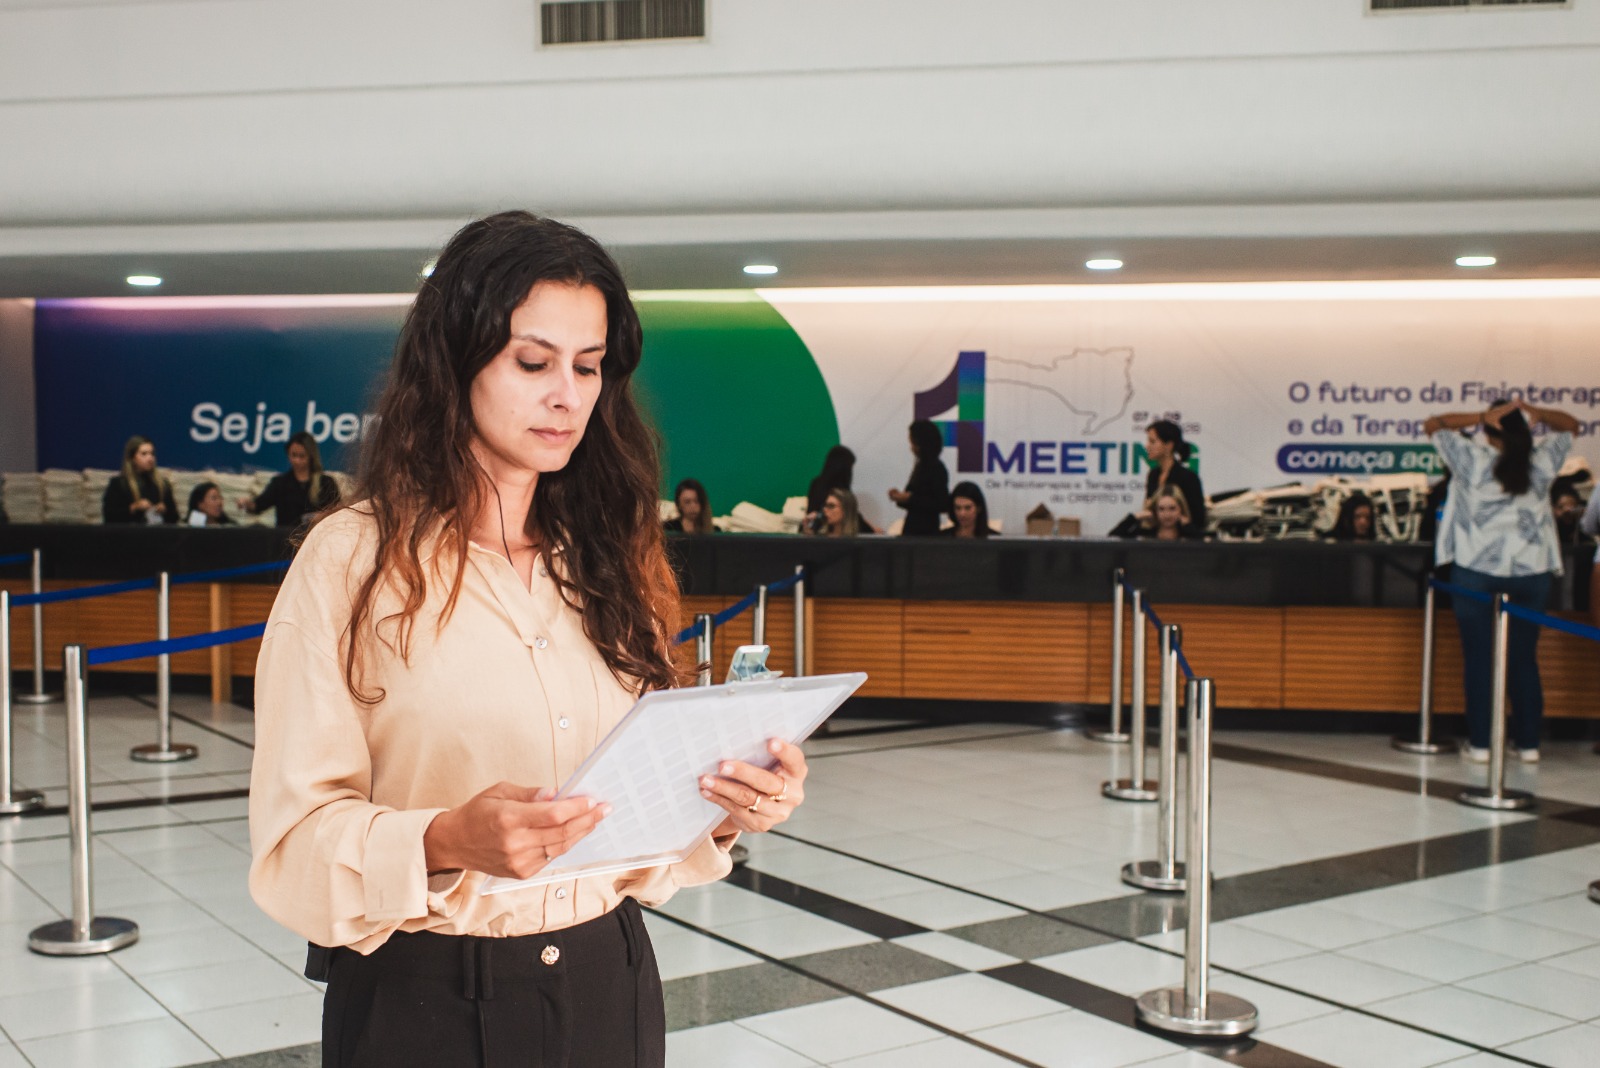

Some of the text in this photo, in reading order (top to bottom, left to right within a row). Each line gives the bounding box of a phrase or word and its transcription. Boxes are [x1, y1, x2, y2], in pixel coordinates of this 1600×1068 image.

[1289, 382, 1310, 404] O
[1318, 381, 1412, 404] futuro
[1420, 381, 1453, 404] da
[914, 351, 986, 473] 1
[189, 402, 292, 454] Seja
[1288, 415, 1426, 439] e da Terap
[1287, 449, 1394, 472] começa
